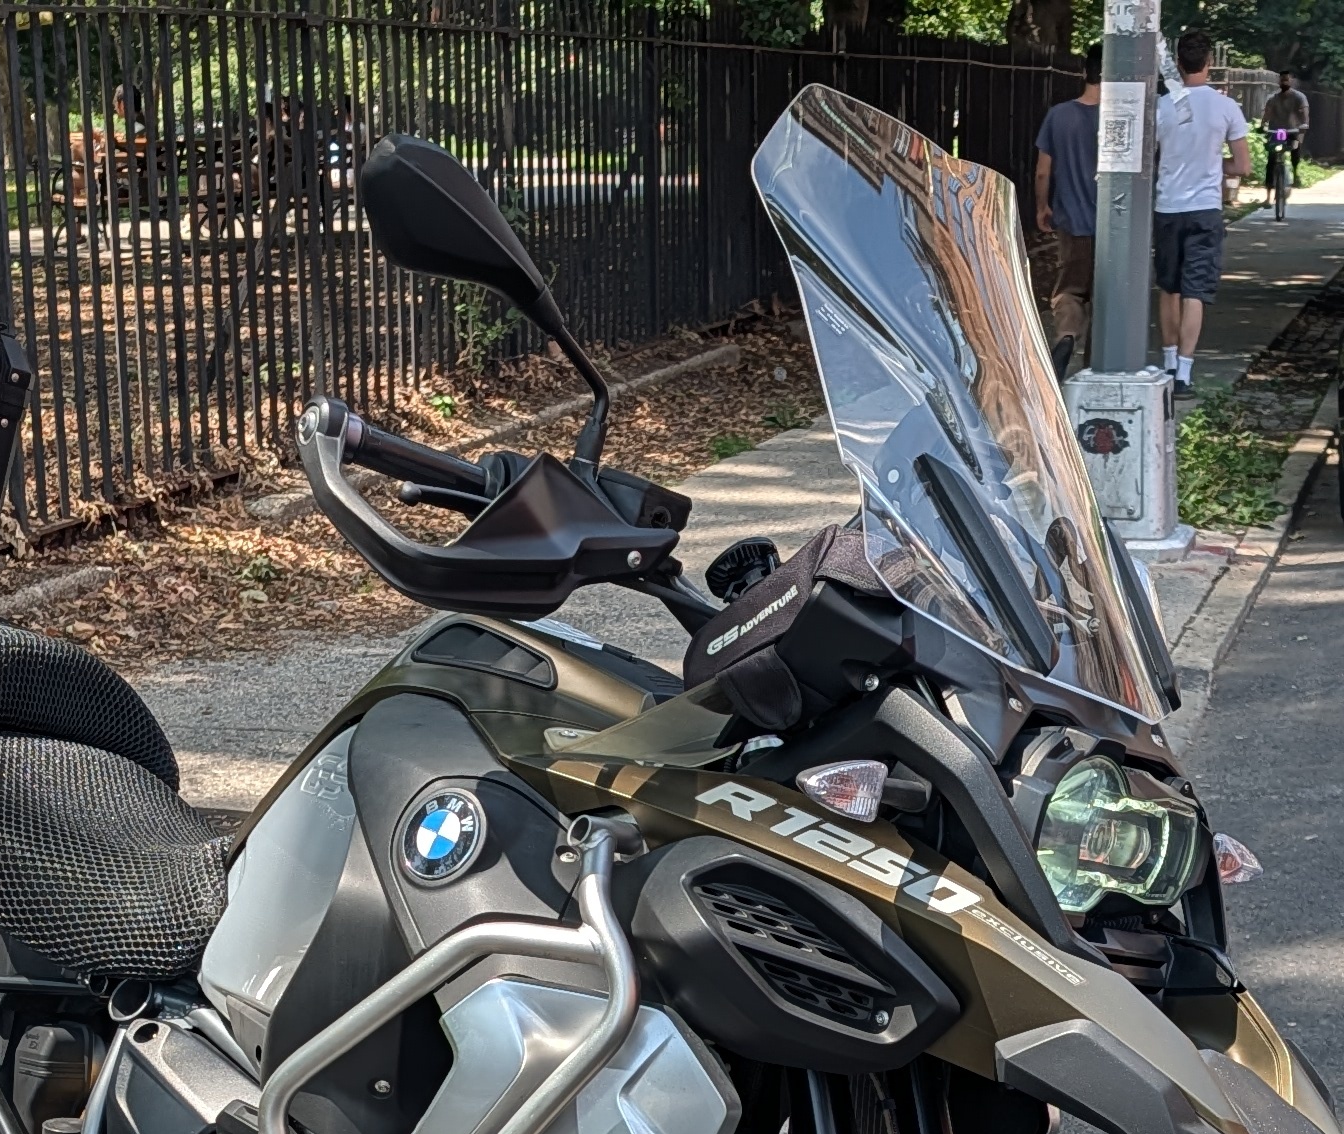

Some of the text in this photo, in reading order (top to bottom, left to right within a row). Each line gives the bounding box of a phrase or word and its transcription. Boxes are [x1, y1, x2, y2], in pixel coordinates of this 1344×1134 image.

[706, 584, 799, 655] GS ADVENTURE
[425, 799, 474, 832] BMW
